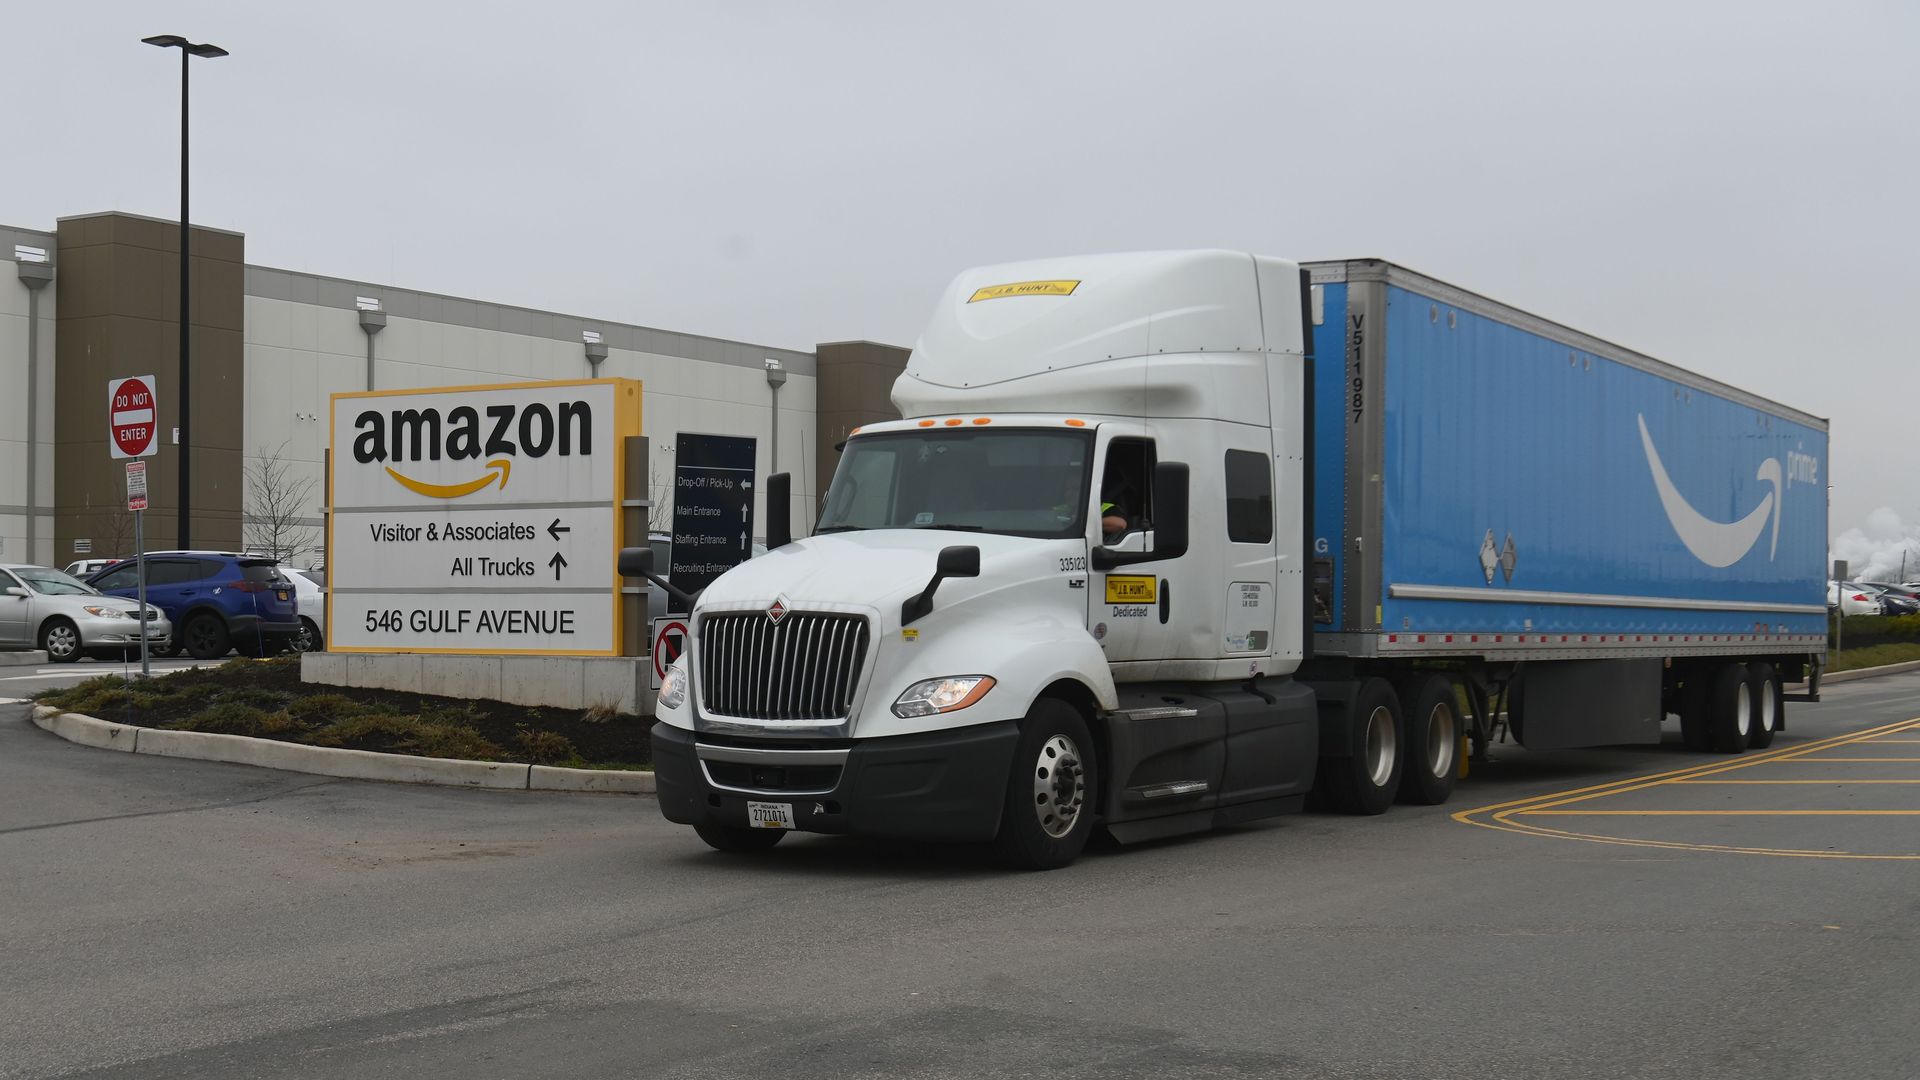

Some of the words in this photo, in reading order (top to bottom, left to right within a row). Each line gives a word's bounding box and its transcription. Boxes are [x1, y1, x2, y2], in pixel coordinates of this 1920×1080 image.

[1352, 314, 1364, 424] V511987
[117, 396, 128, 407] DO
[133, 393, 148, 405] NOT
[121, 428, 146, 441] ENTER
[353, 400, 592, 464] amazon
[1787, 441, 1817, 488] prime
[678, 476, 706, 488] Drop-Off
[710, 478, 734, 489] Pick-Up
[676, 505, 693, 516] Main
[694, 506, 721, 516] Entrance
[370, 523, 422, 542] Visitor
[426, 522, 439, 541] &
[442, 520, 536, 541] Associates
[675, 534, 699, 547] Staffing
[700, 535, 727, 545] Entrance
[1315, 538, 1328, 553] G
[451, 557, 473, 576] All
[478, 557, 535, 576] Trucks
[673, 562, 705, 575] Recruiting
[1060, 556, 1086, 571] 335123
[1130, 585, 1144, 595] HUNT
[1113, 606, 1147, 617] Dedicated
[365, 609, 403, 633] 546
[409, 609, 472, 633] GULF
[476, 609, 575, 634] AVENUE
[754, 809, 787, 822] 2721071
